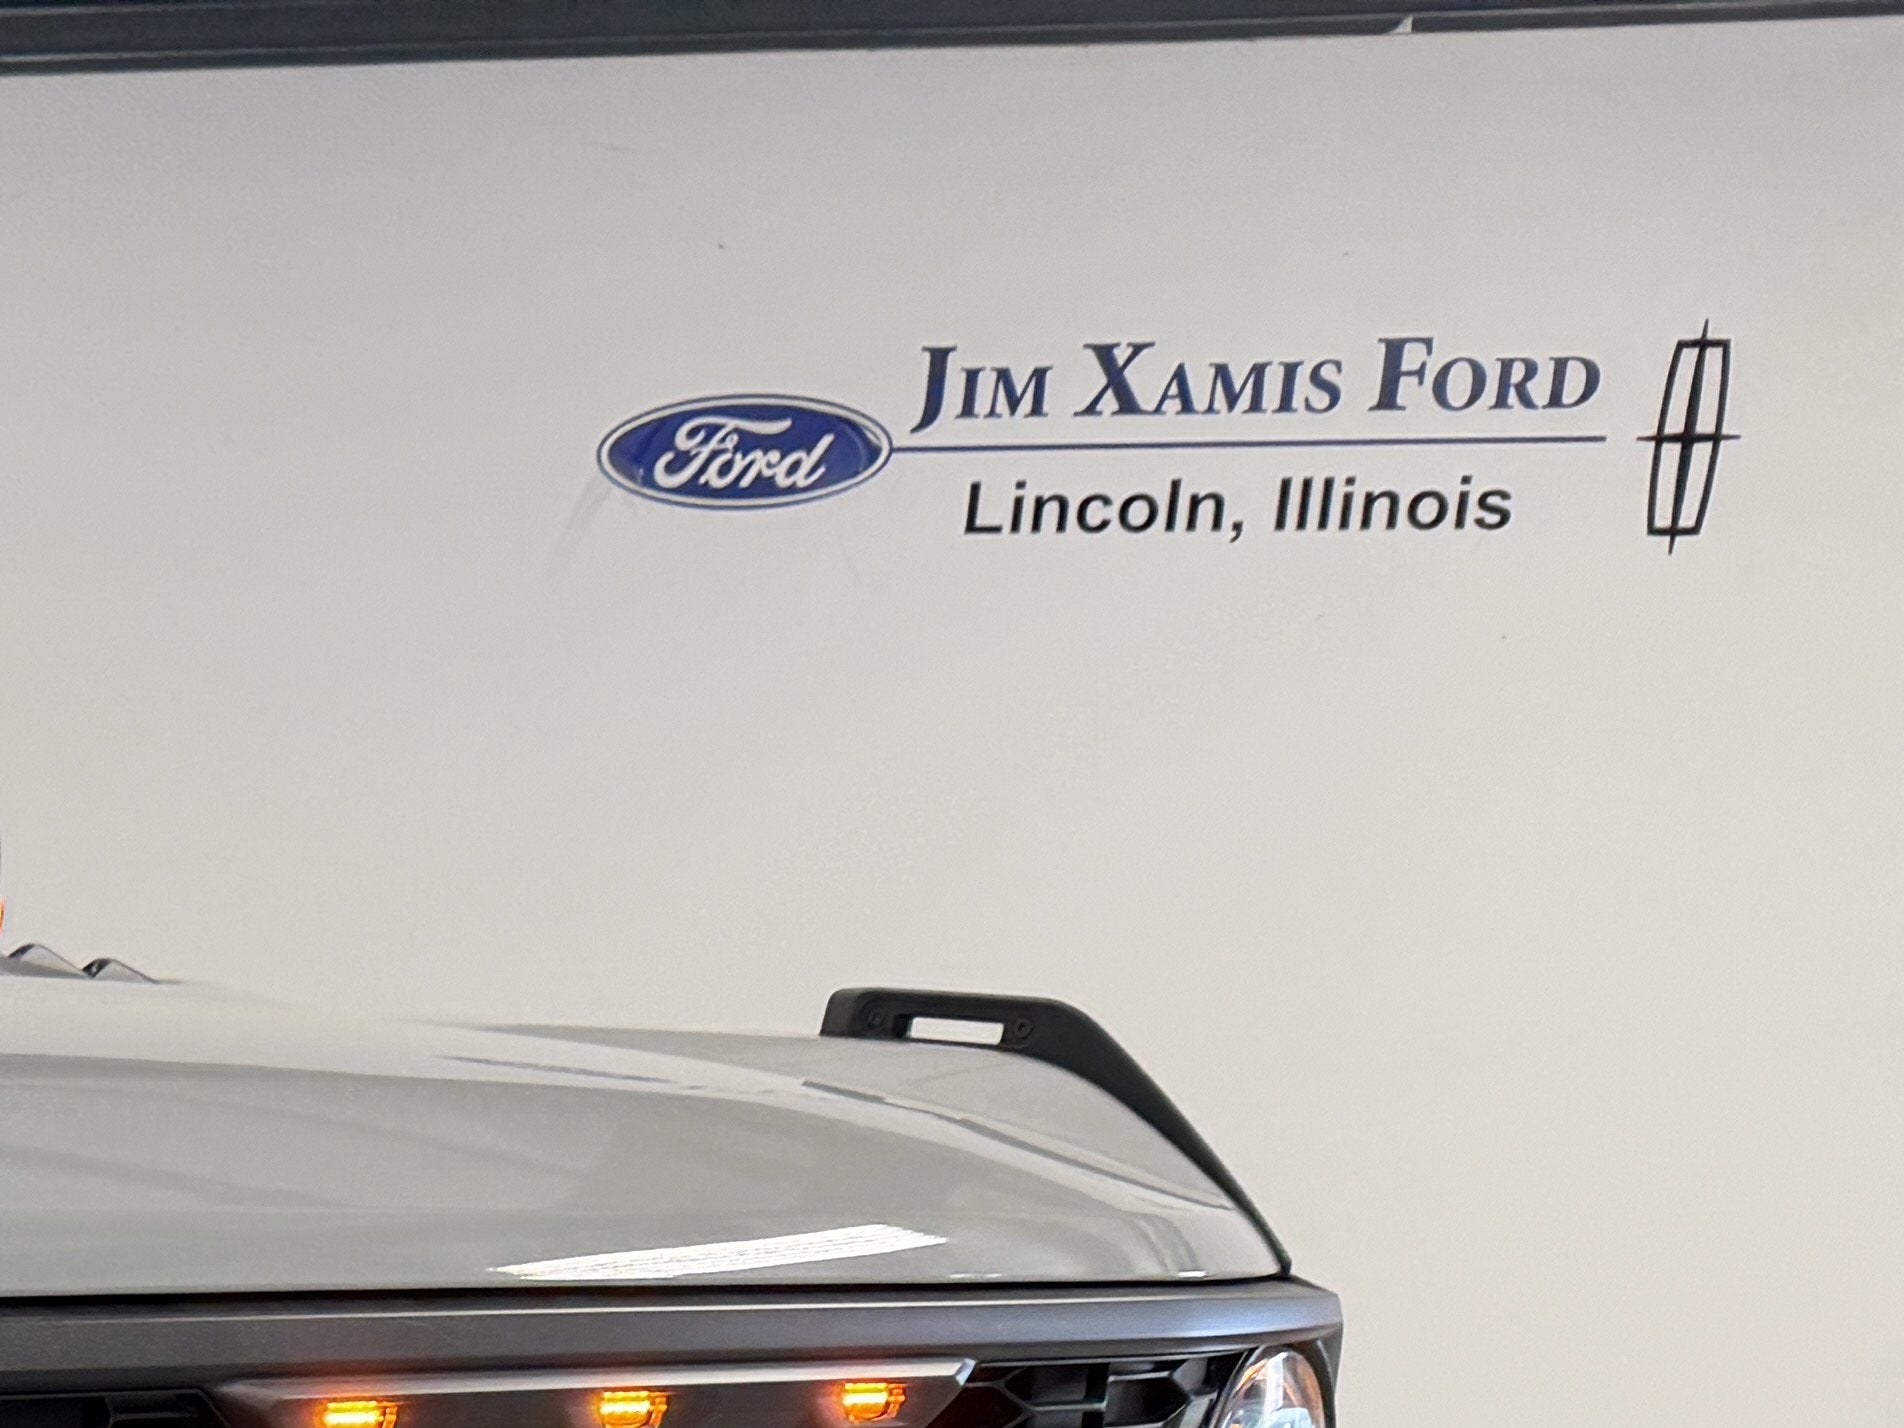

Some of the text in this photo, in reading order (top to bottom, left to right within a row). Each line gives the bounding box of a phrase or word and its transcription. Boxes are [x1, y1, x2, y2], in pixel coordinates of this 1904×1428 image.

[910, 336, 1602, 435] JIM XAMIS FORD
[653, 416, 836, 489] Ford
[963, 475, 1512, 544] Lincoln, Illinois
